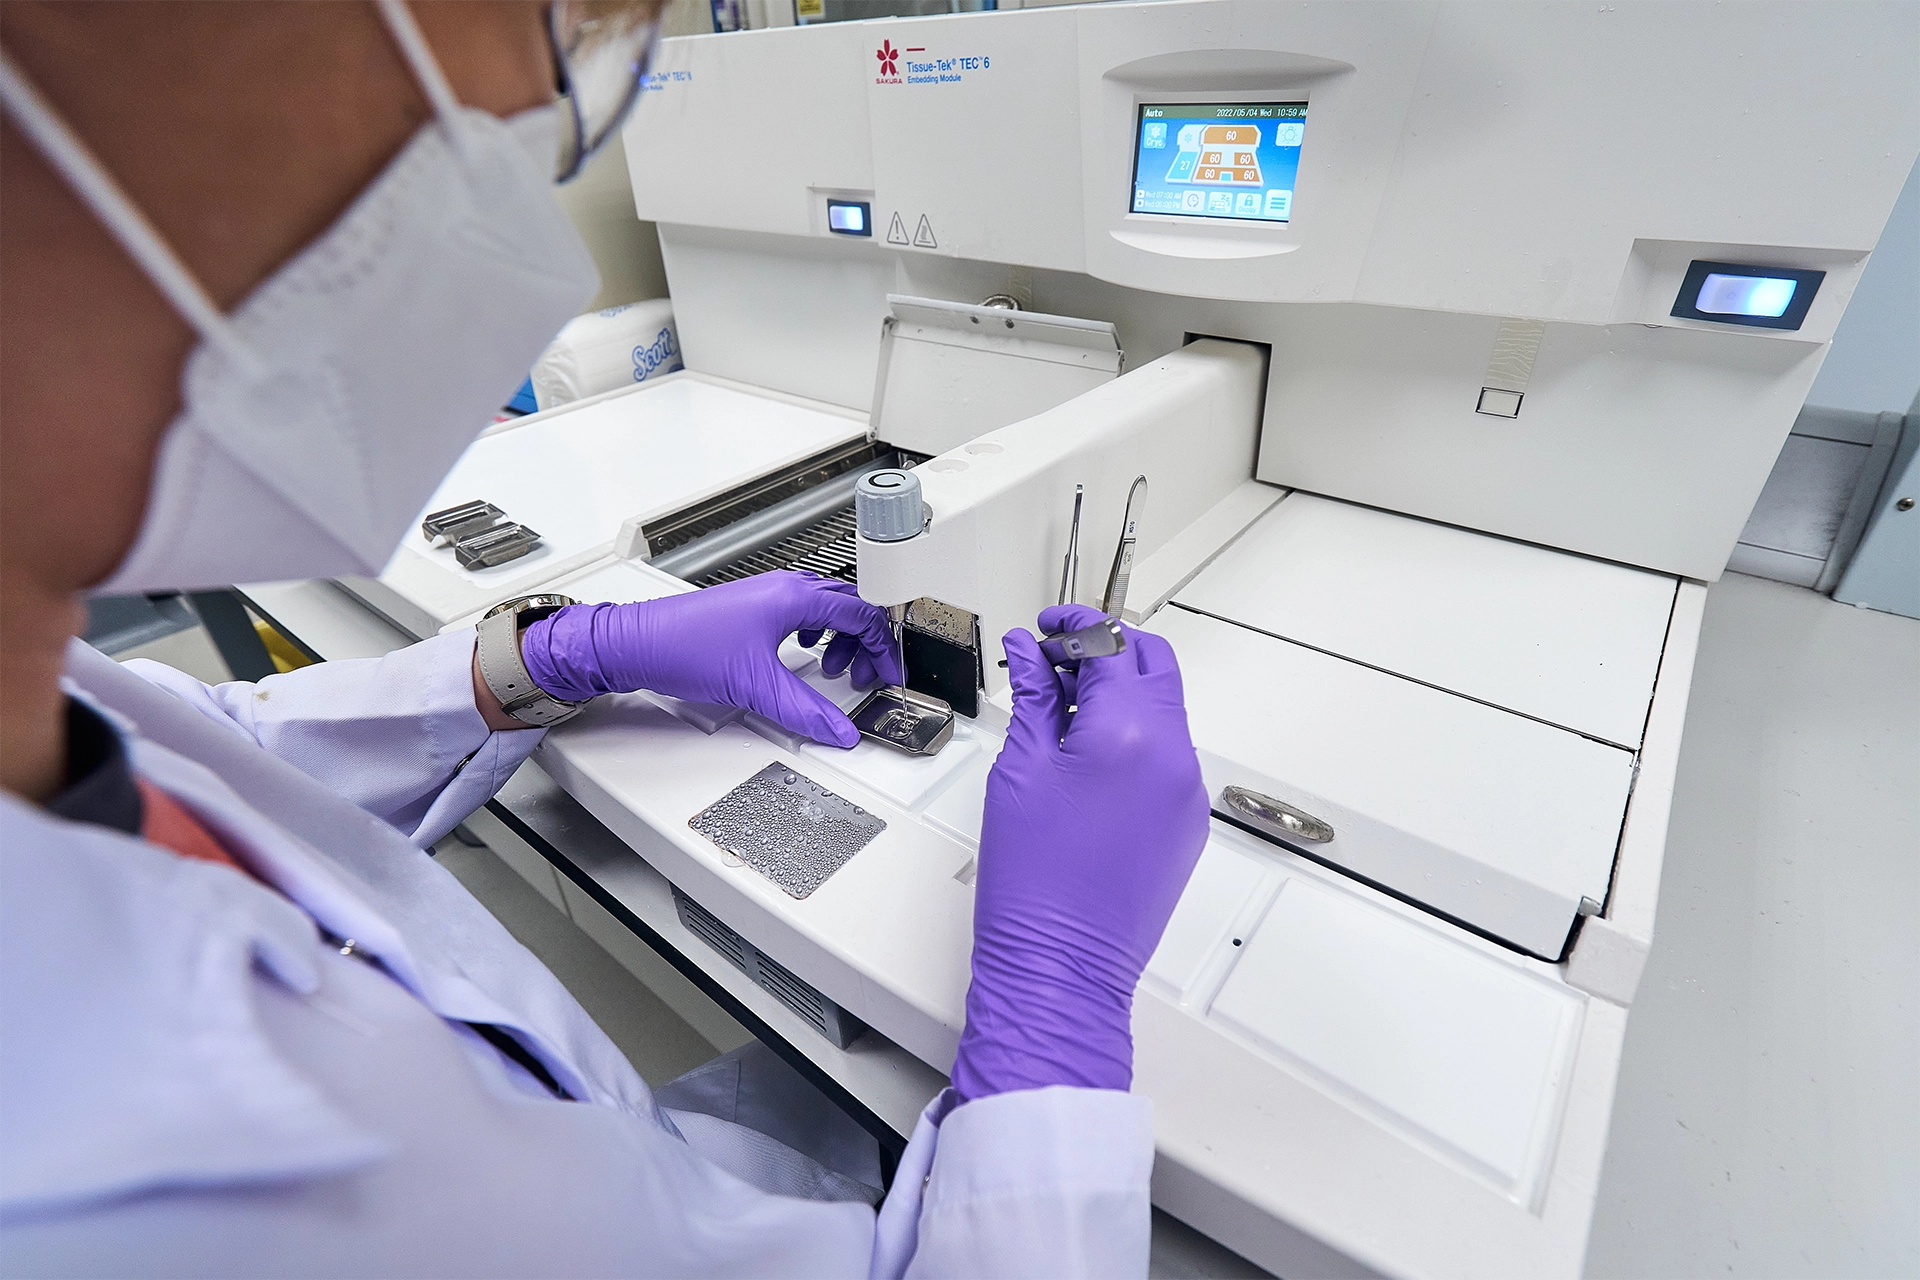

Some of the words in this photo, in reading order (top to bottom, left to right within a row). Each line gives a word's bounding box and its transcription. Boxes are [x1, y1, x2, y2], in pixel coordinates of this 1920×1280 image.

[907, 74, 939, 84] Embedding
[939, 73, 962, 82] Module
[1145, 108, 1163, 117] Auto
[1216, 108, 1258, 117] 2022/05/04
[1259, 108, 1273, 117] Wed
[1277, 108, 1298, 117] 10:59
[1226, 130, 1238, 141] 60
[1209, 153, 1221, 164] 60
[1240, 154, 1251, 165] 60
[1180, 160, 1191, 171] 27
[1204, 168, 1215, 179] 60
[1243, 169, 1255, 180] 60
[631, 327, 677, 382] Scott
